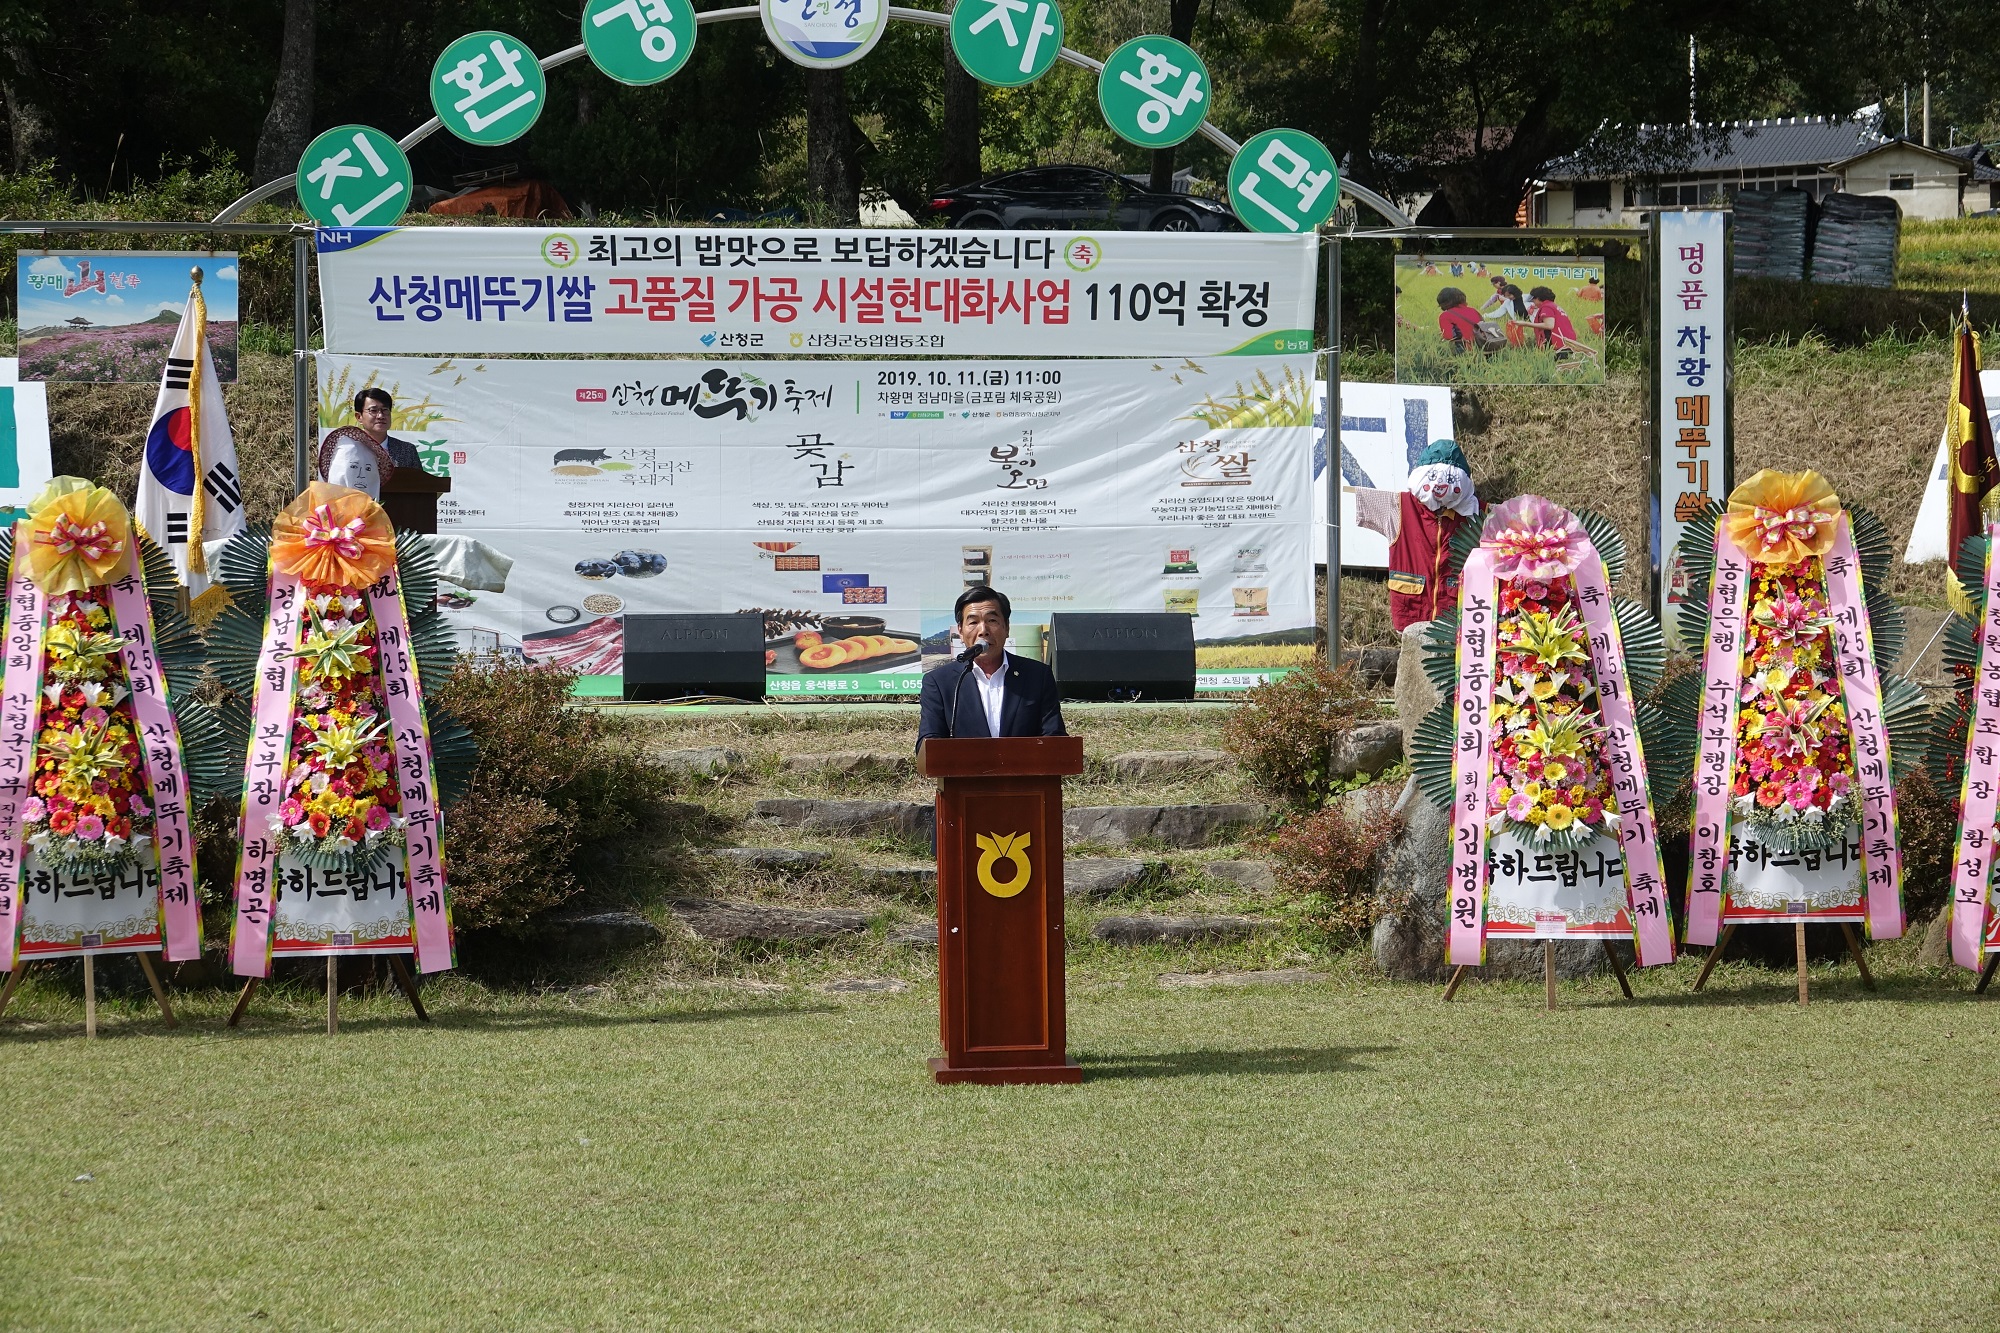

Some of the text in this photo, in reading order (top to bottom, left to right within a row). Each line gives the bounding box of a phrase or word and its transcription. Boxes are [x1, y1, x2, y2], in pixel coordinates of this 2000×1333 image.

[442, 40, 535, 133] 환
[1120, 46, 1203, 134] 황
[307, 133, 403, 227] 친
[1238, 138, 1333, 231] 면
[321, 232, 352, 243] NH
[549, 235, 1094, 269] 축 최고의 밥맛으로 보답하겠습니다 축
[1503, 267, 1599, 280] 차황 메뚜기잡기
[1677, 243, 1708, 311] 명품
[369, 276, 1270, 327] 산청메뚜기쌀 고품질 가공 시설현대화사업 110억 확정
[720, 333, 764, 347] 산청군
[807, 334, 945, 348] 산청군농업협동조합
[1287, 341, 1309, 350] 농협
[1676, 325, 1711, 388] 차황
[579, 391, 605, 400] 제25회
[611, 368, 834, 421] 산청 메뚜기 축제
[877, 371, 922, 386] 2019.
[928, 371, 952, 386] 10.
[1015, 370, 1062, 385] 11:00
[877, 391, 913, 404] 차황면
[1009, 390, 1062, 404] 체육공원)
[619, 448, 656, 460] 산청
[639, 461, 694, 473] 지리산
[1174, 439, 1222, 454] 산청
[1211, 452, 1257, 478] 쌀
[619, 473, 674, 486] 흑돼지
[1580, 586, 1604, 607] 축
[264, 585, 295, 692] 경남농협
[769, 680, 923, 691] 산청읍 웅석봉로 3 Tel. 055
[1196, 676, 1218, 686] 엔청
[1590, 632, 1619, 701] 제25회
[1693, 558, 1744, 894] 농협은행 수석부행장 이창호
[1827, 555, 1895, 889] 축 제25회 산청메뚜기축제
[123, 624, 156, 697] 제25회
[144, 723, 191, 905] 산청메뚜기축제
[250, 724, 284, 806] 본부장
[369, 575, 441, 915] 祝 제25회 산청메뚜기축제
[1454, 594, 1492, 929] 농협중앙회 회장 김병원
[1955, 829, 1989, 905] 황성보
